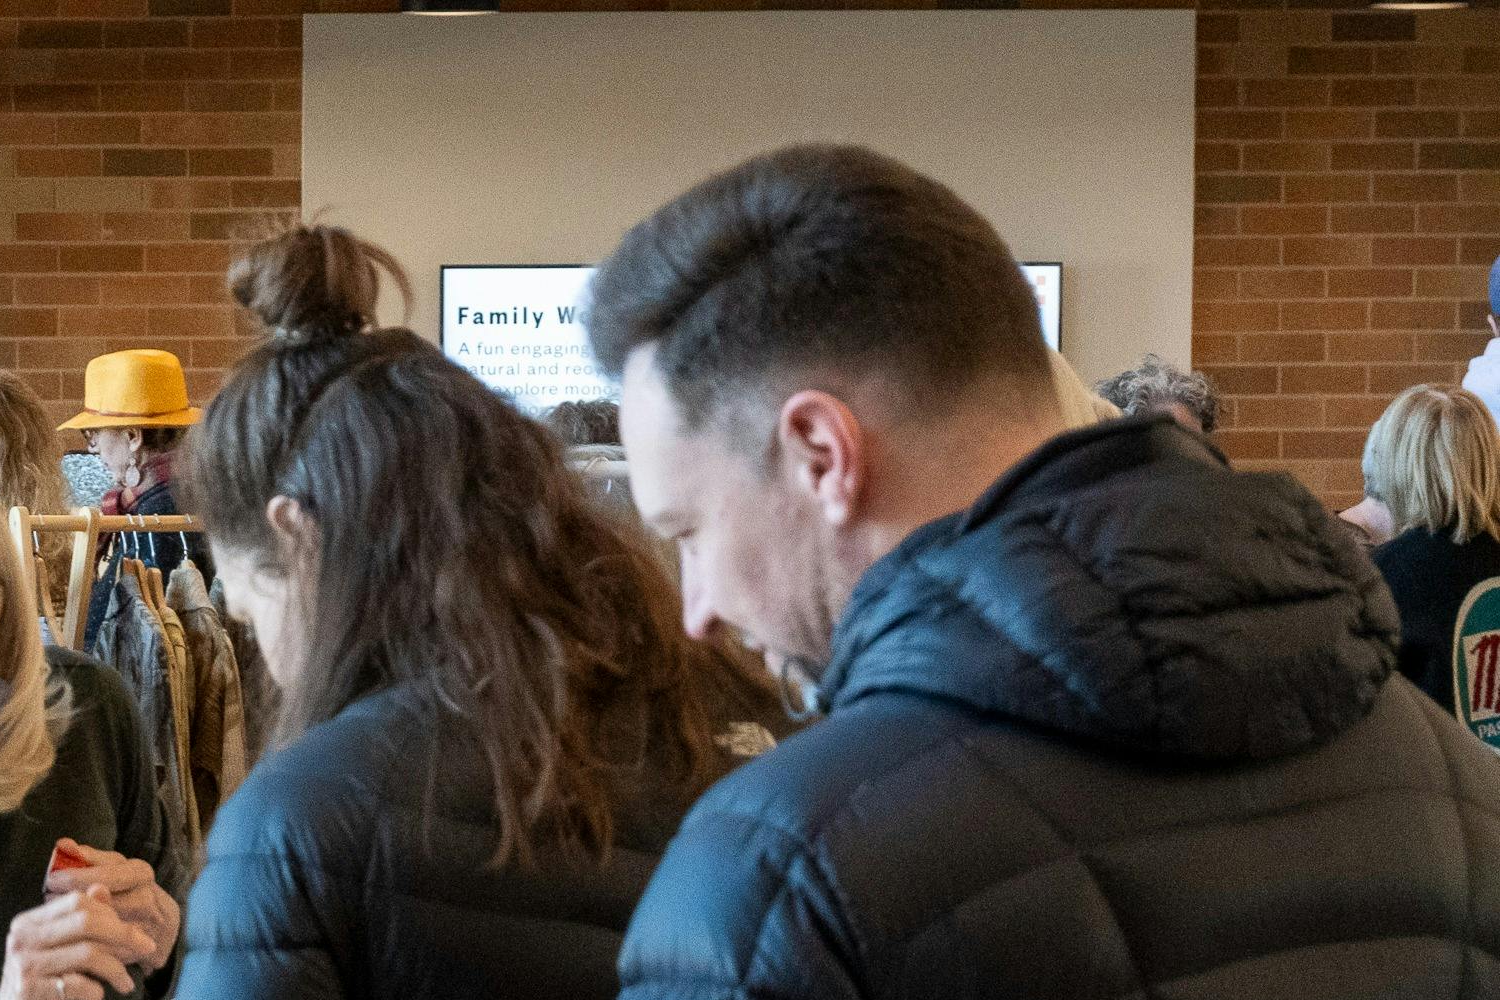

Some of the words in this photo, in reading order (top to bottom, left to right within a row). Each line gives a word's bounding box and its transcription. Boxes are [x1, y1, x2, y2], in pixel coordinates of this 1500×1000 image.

[457, 306, 544, 329] Family
[458, 342, 470, 356] A
[476, 341, 504, 356] fun
[510, 343, 590, 358] engaging
[527, 362, 559, 376] and
